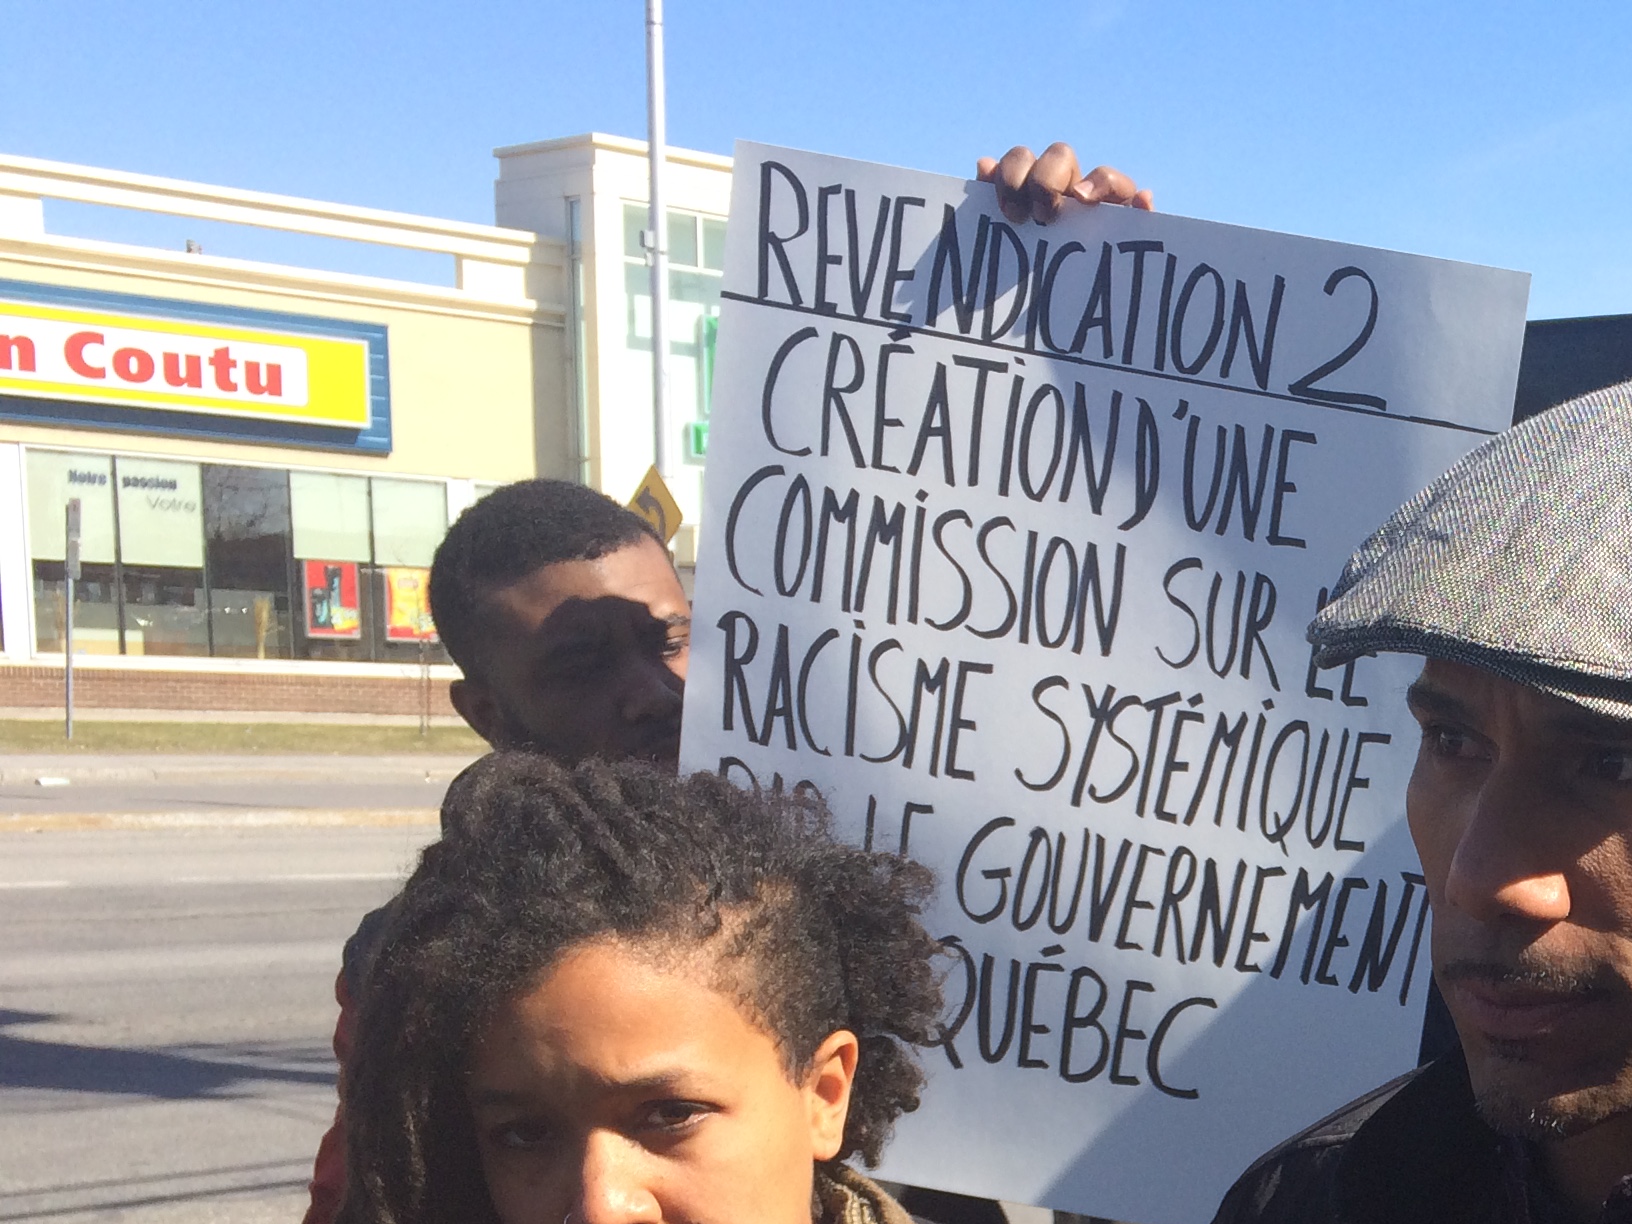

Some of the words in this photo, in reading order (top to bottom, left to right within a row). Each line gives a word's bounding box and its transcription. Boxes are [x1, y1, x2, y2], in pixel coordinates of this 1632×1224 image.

[64, 330, 283, 398] Coutu
[757, 160, 1285, 390] REVENDICATION
[1287, 266, 1387, 410] 2
[762, 325, 1122, 516] CRÉATION
[1118, 396, 1318, 550] D'UNE
[725, 463, 1127, 657] COMMISSION
[1155, 556, 1282, 692] SUR
[717, 609, 994, 782] RACISME
[1013, 676, 1393, 856] SYSTÉMIQUE
[928, 934, 1218, 1100] QUÉBEC
[956, 816, 1429, 1007] GOUVERNEMENT
